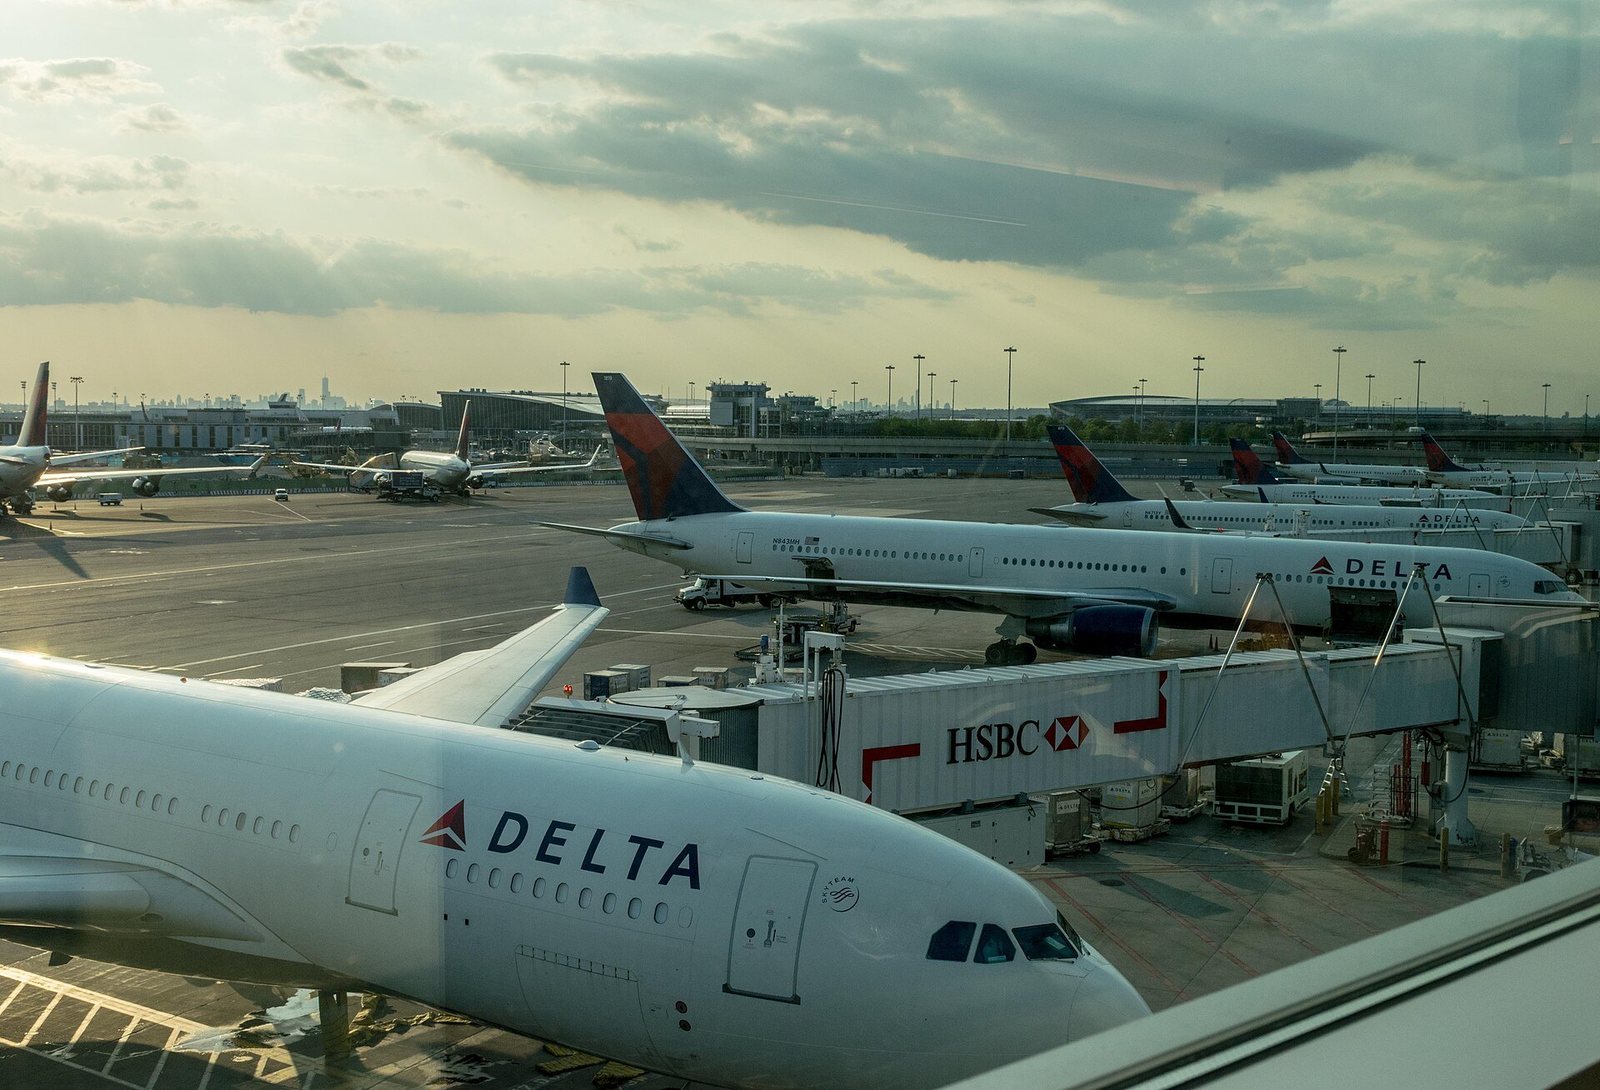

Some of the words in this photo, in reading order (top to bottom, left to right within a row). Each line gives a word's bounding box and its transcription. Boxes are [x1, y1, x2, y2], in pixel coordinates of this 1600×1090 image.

[1434, 514, 1481, 523] DELTA
[946, 720, 1040, 764] HSBC
[487, 811, 700, 890] DELTA
[822, 876, 855, 903] SKYTEAM
